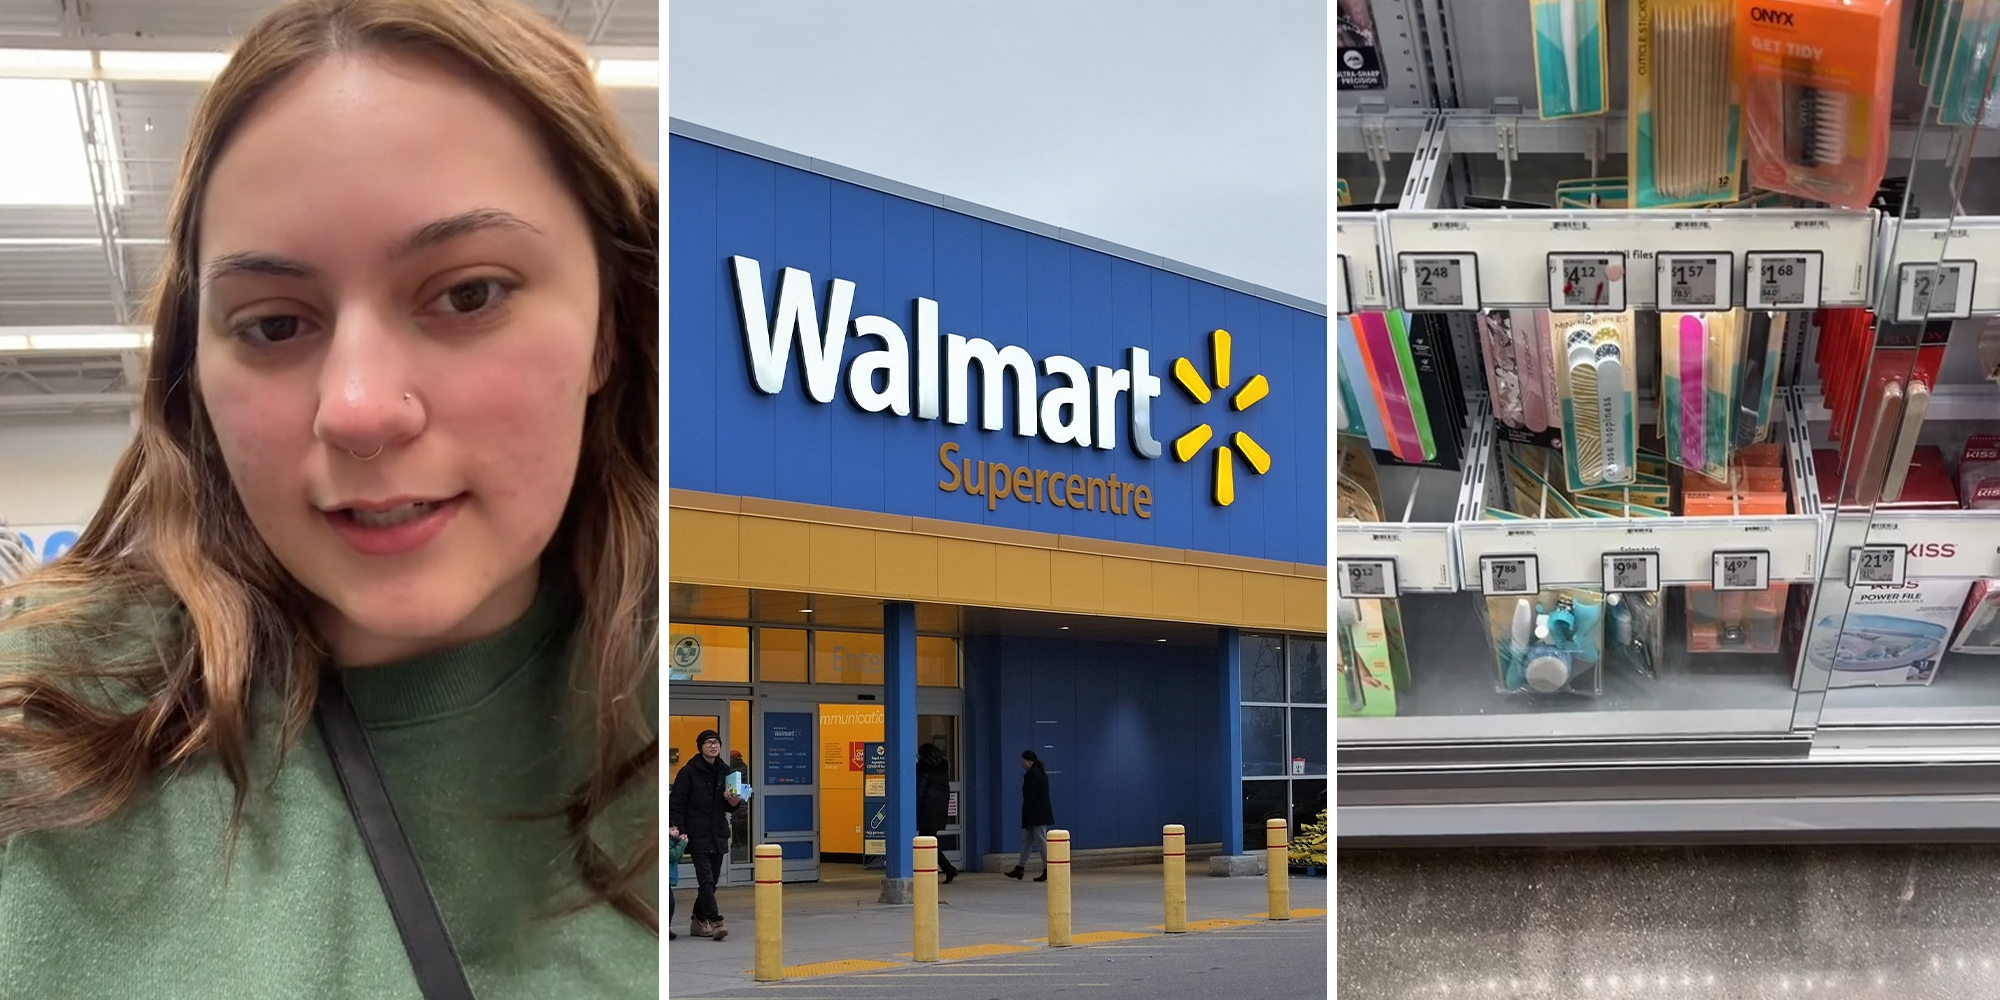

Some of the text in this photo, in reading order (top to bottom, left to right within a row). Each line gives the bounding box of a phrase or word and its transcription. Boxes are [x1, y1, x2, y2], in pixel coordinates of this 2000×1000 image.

[1751, 7, 1794, 26] ONYX
[1638, 36, 1647, 75] CUTICLE
[1752, 37, 1824, 61] GET TIDY
[1718, 176, 1729, 186] 12
[1632, 250, 1653, 259] files
[732, 254, 1162, 459] Walmart
[1603, 397, 1616, 444] happiness
[938, 442, 1152, 519] Supercentre
[833, 645, 884, 674] Ente
